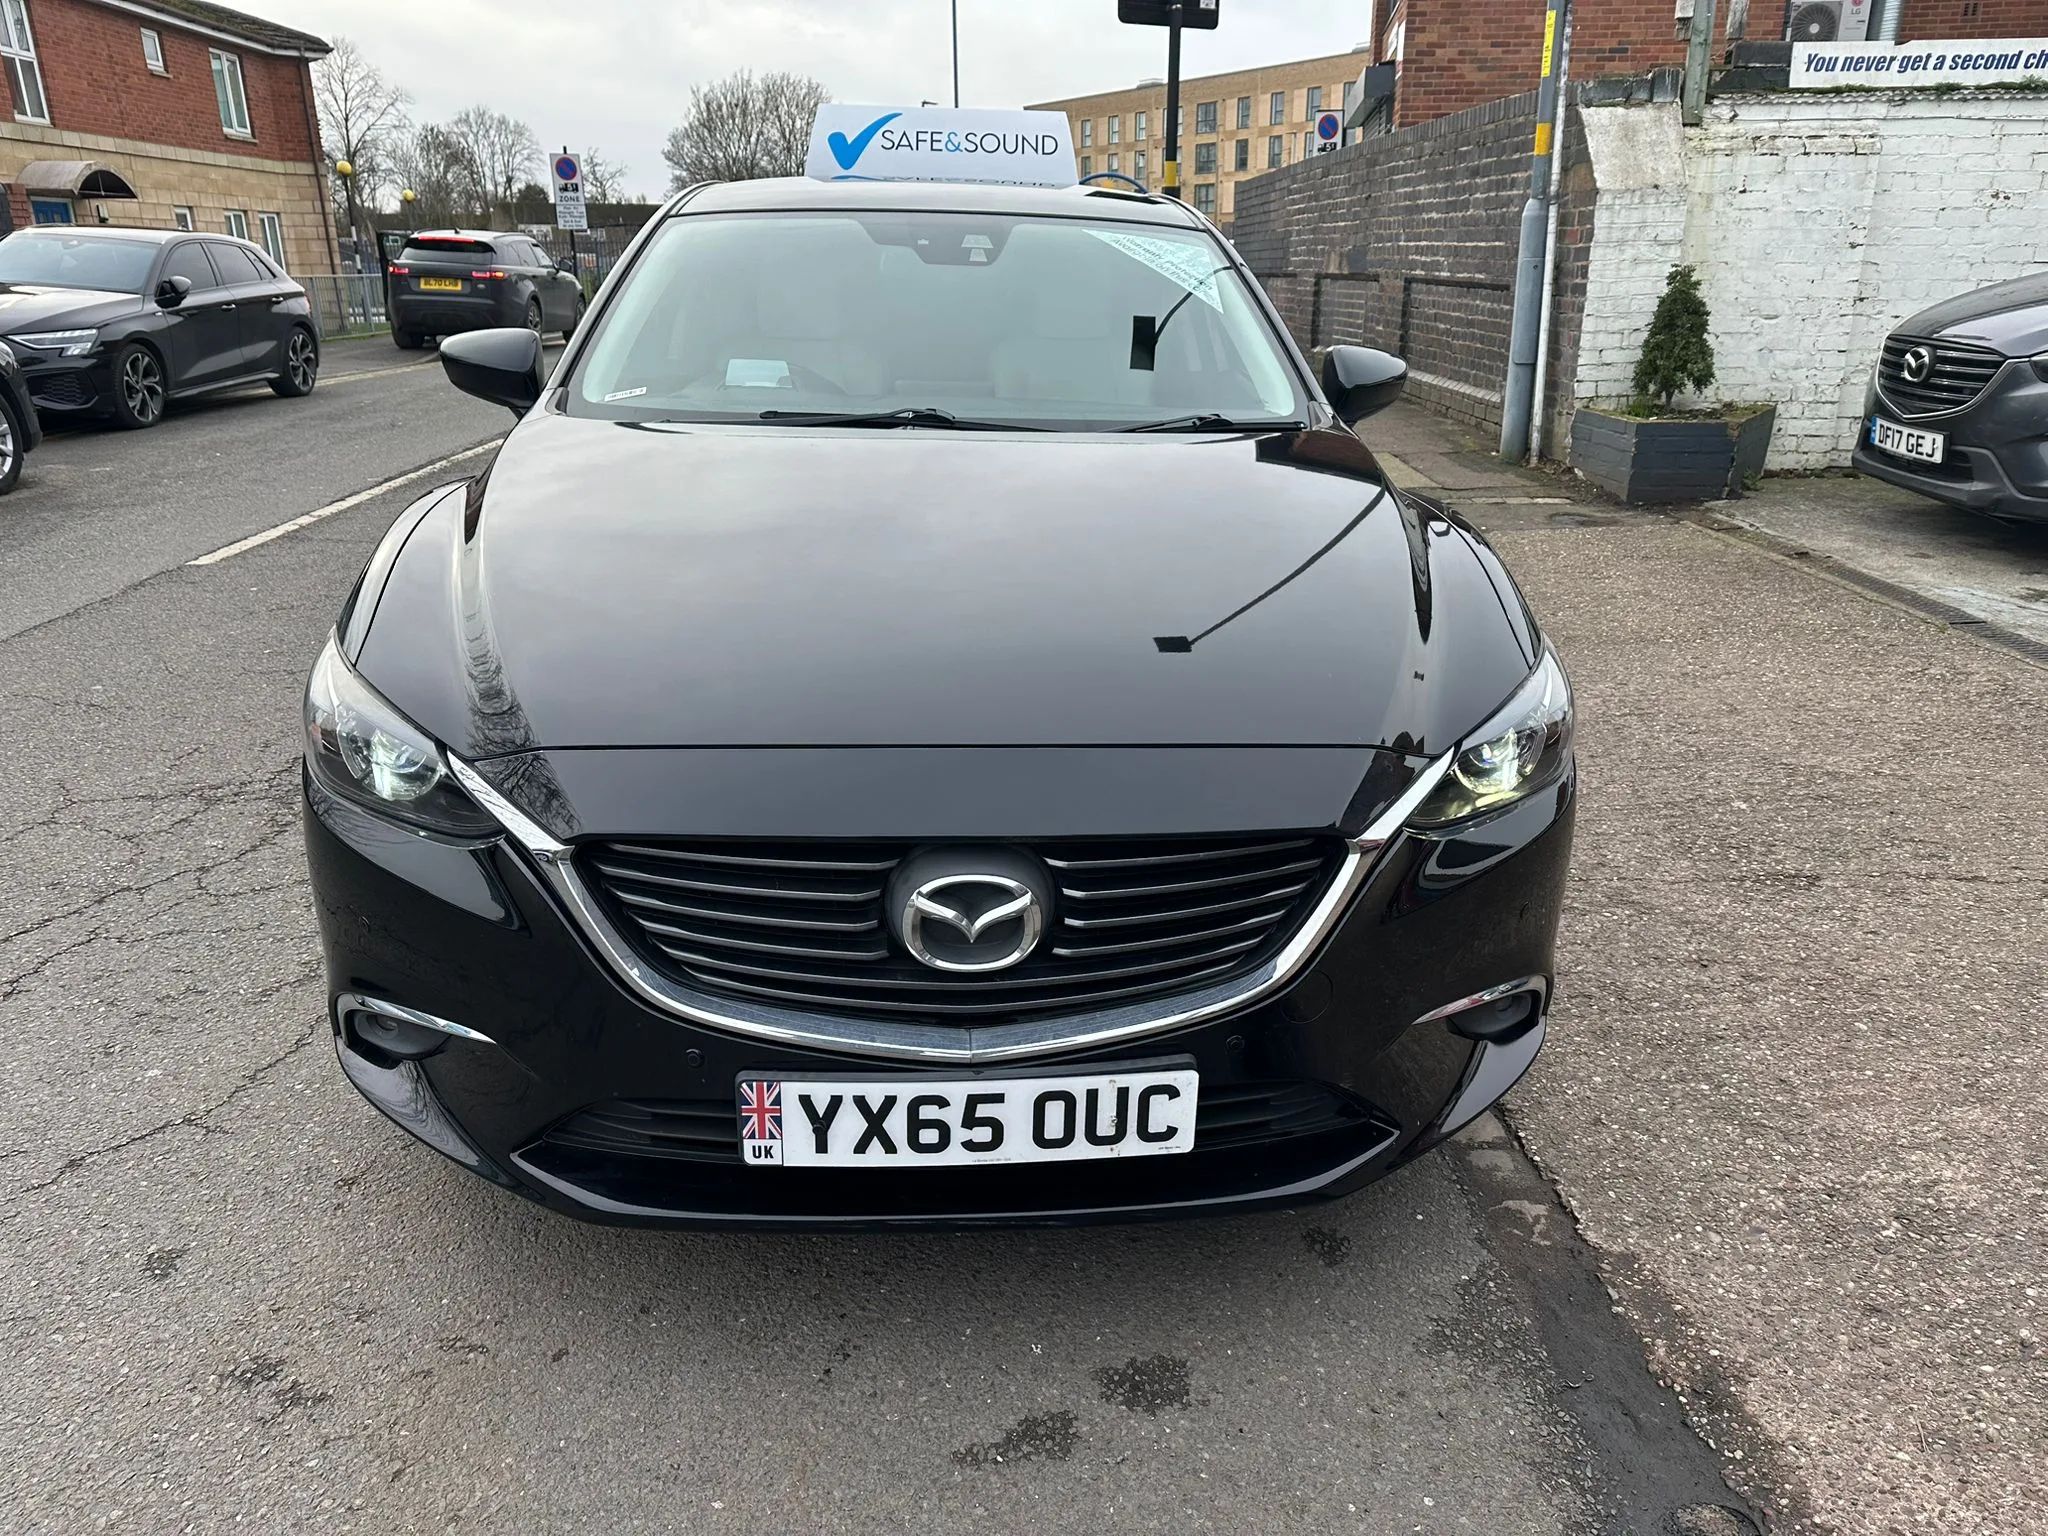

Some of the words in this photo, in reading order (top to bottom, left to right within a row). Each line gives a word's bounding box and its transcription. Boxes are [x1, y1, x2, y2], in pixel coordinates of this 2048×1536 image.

[1805, 53, 1840, 72] You
[1840, 55, 1898, 72] never
[1897, 53, 1932, 74] get
[1932, 54, 1947, 71] a
[1949, 50, 2024, 70] second
[881, 129, 1059, 156] SAFE&SOUND
[559, 195, 580, 203] ZONE
[1878, 423, 1904, 450] DF17
[1906, 432, 1937, 458] GEJ
[798, 1093, 1005, 1154] YX65
[1032, 1083, 1181, 1149] OUC
[752, 1144, 775, 1159] UK
